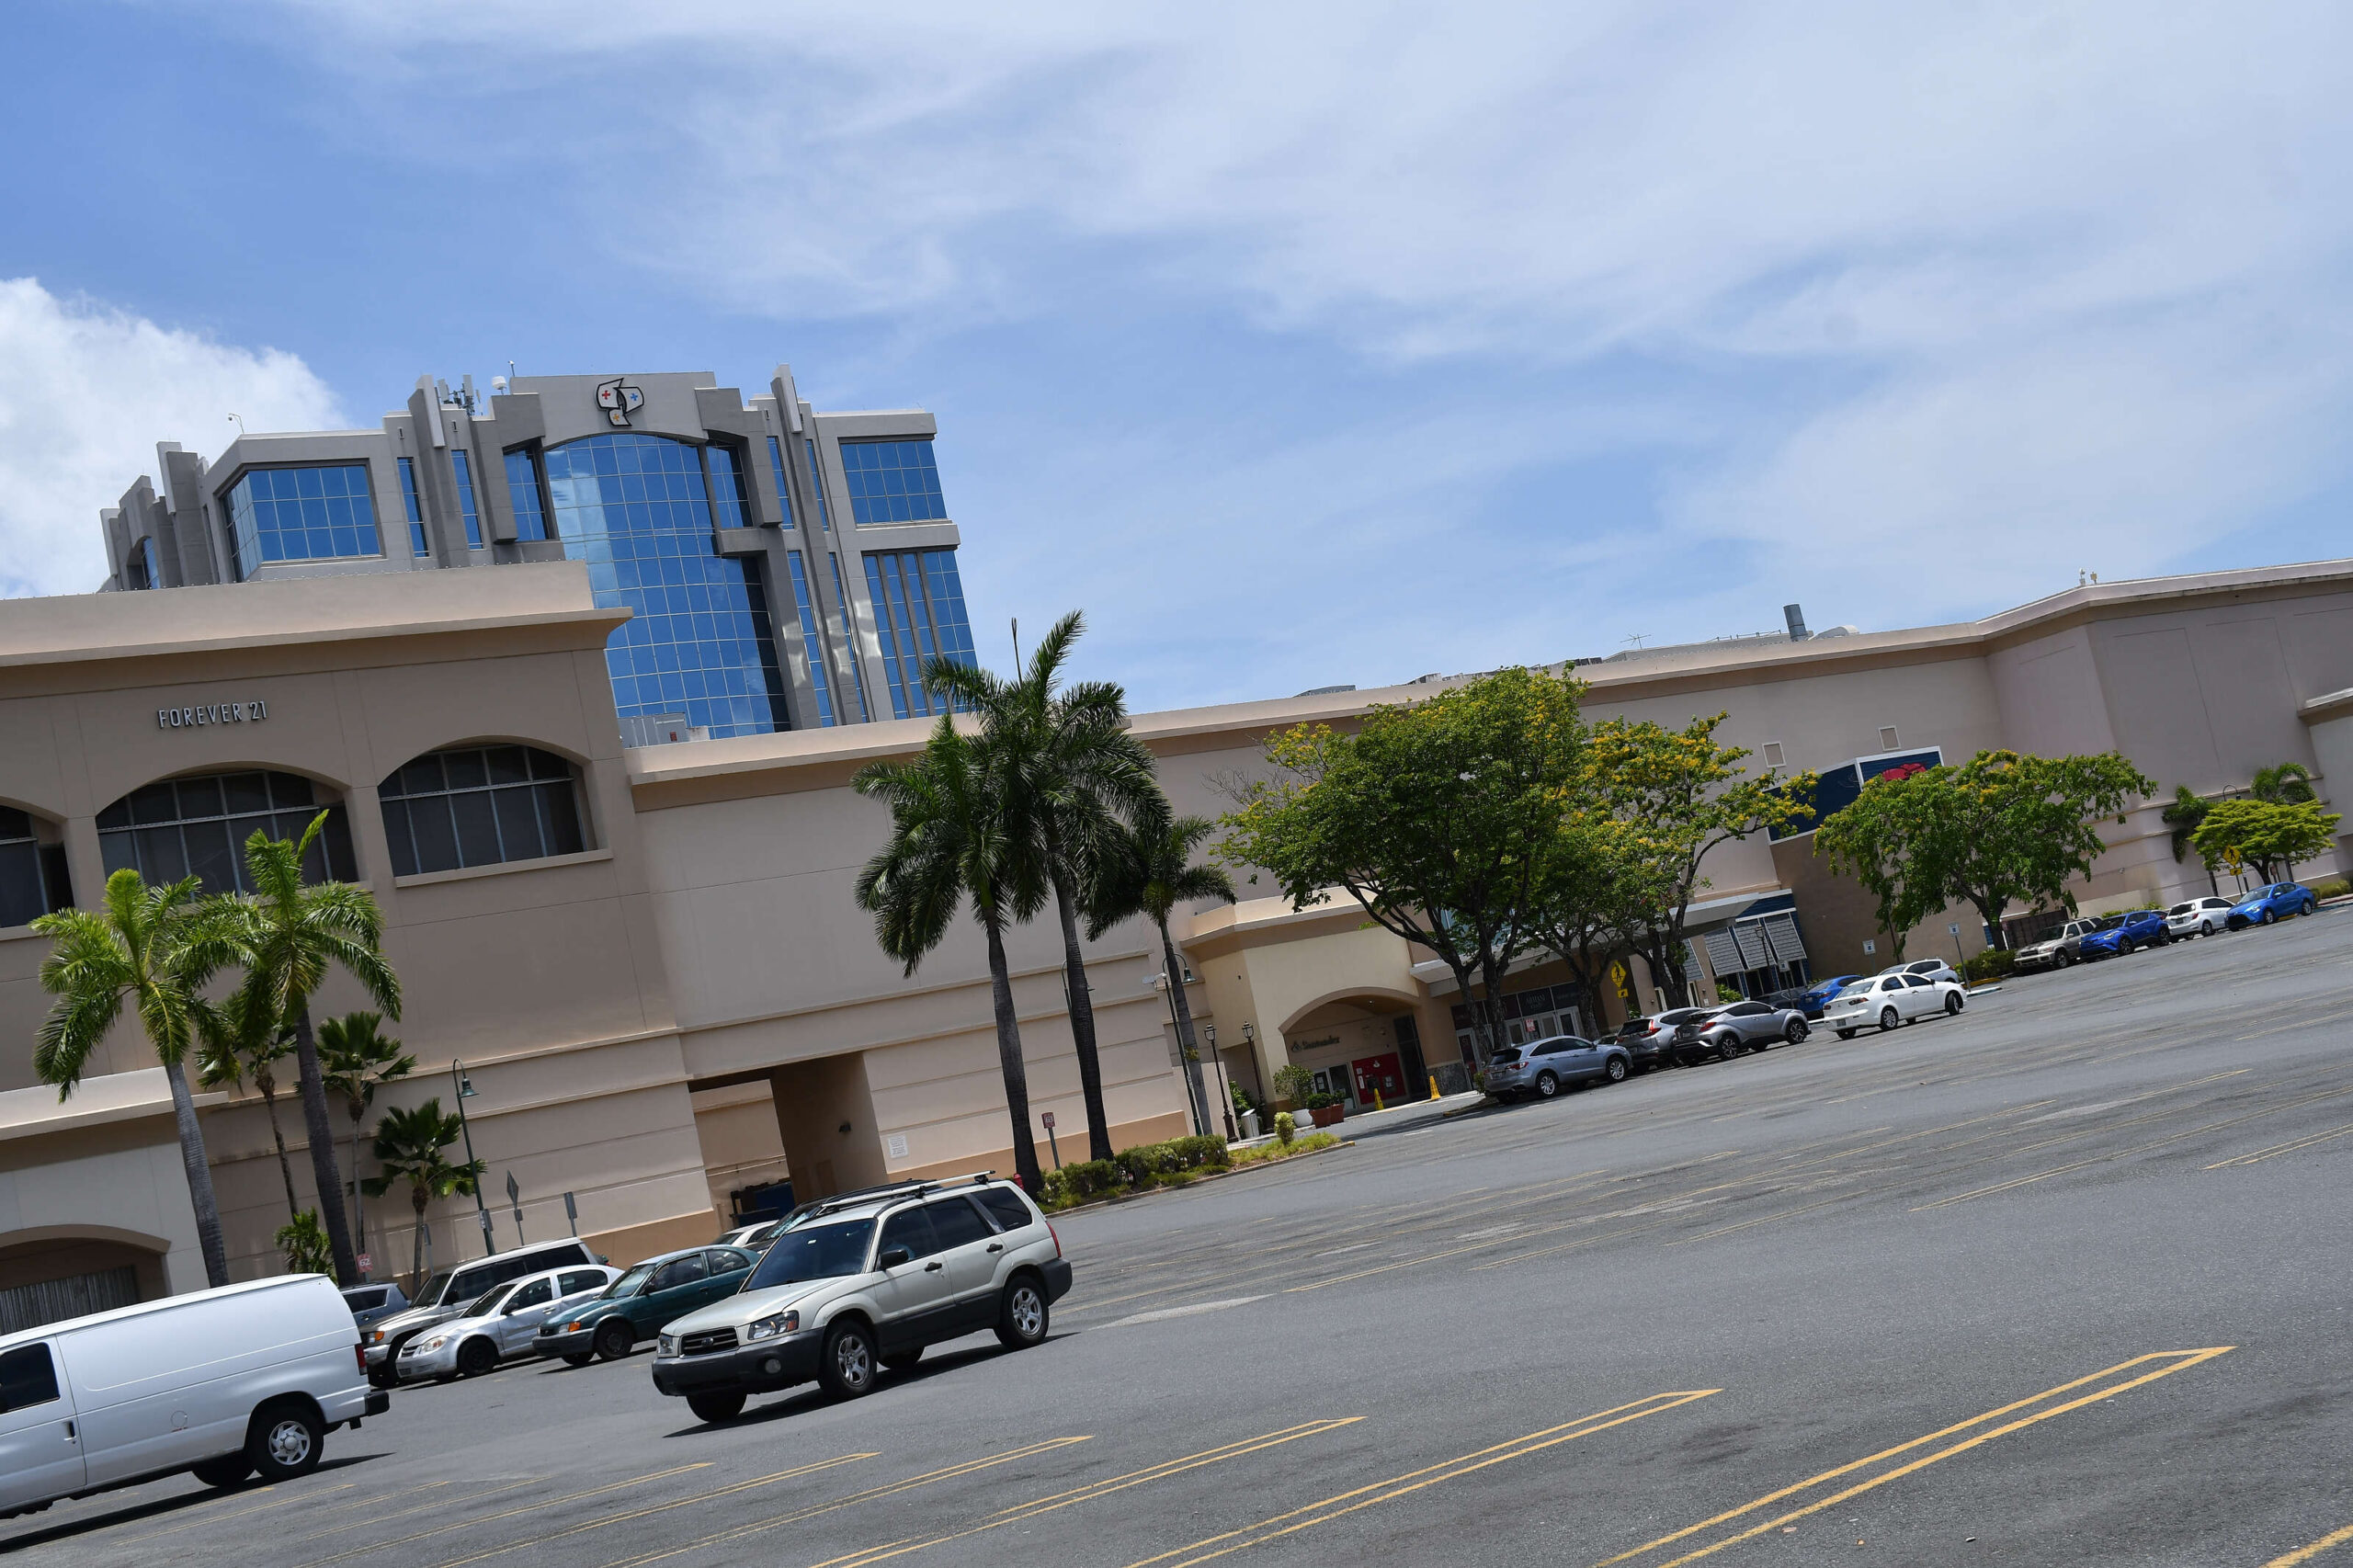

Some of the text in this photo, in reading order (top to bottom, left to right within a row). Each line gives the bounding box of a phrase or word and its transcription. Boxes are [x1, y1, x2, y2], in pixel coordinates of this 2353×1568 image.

[157, 700, 267, 729] FOREVER 21
[359, 1257, 371, 1267] 62
